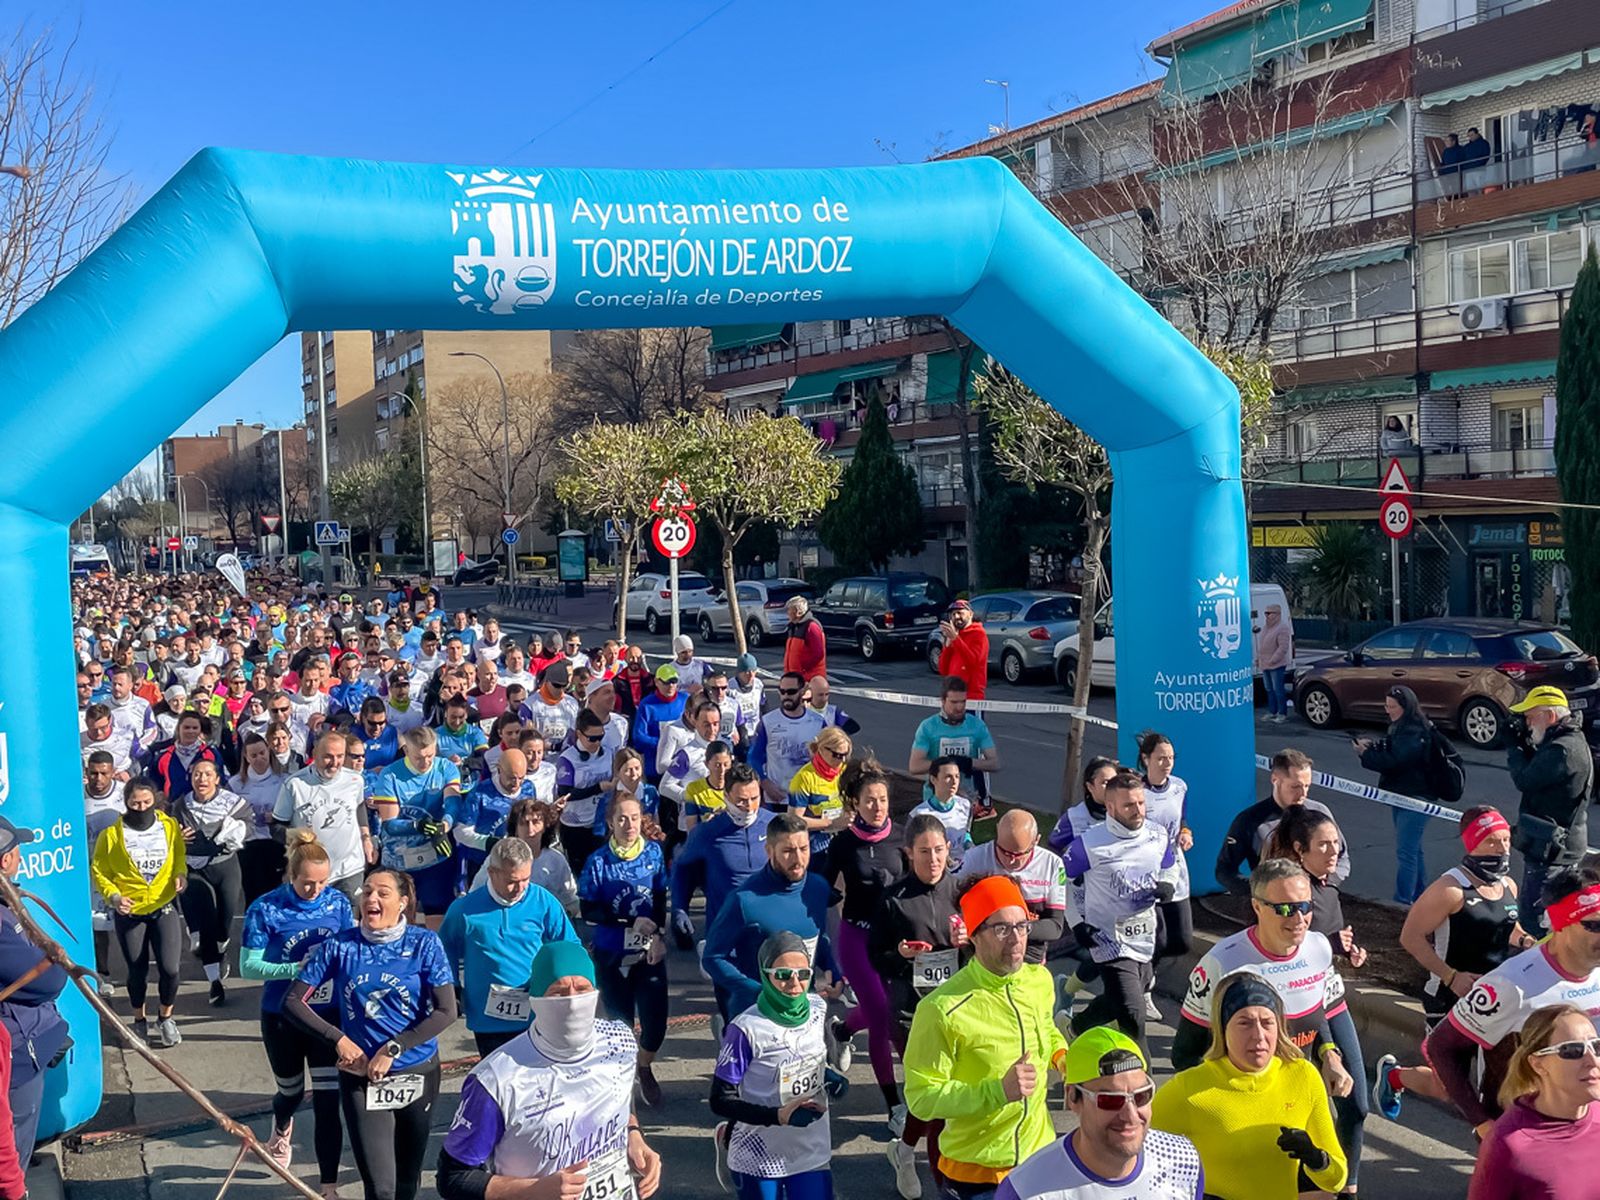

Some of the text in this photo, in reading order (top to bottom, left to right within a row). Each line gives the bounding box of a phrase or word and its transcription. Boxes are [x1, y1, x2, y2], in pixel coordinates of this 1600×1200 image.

[571, 197, 849, 230] Ayuntamiento de
[573, 228, 853, 284] TORREJÓN DE ARDOZ
[575, 288, 823, 308] Concejalía de Deportes
[1388, 510, 1407, 524] 20
[663, 526, 687, 541] 20
[1154, 685, 1225, 714] TORREJÓN
[1227, 687, 1242, 708] DE
[51, 818, 73, 840] de
[14, 845, 75, 881] ARDOZ
[136, 859, 163, 870] 1495
[298, 927, 309, 941] 21
[1124, 923, 1148, 938] 861
[356, 972, 370, 985] 21
[381, 972, 401, 987] WE
[924, 966, 951, 981] 909
[496, 1001, 521, 1016] 411
[791, 1072, 818, 1096] 692
[374, 1088, 416, 1104] 1047
[581, 1173, 618, 1200] 451
